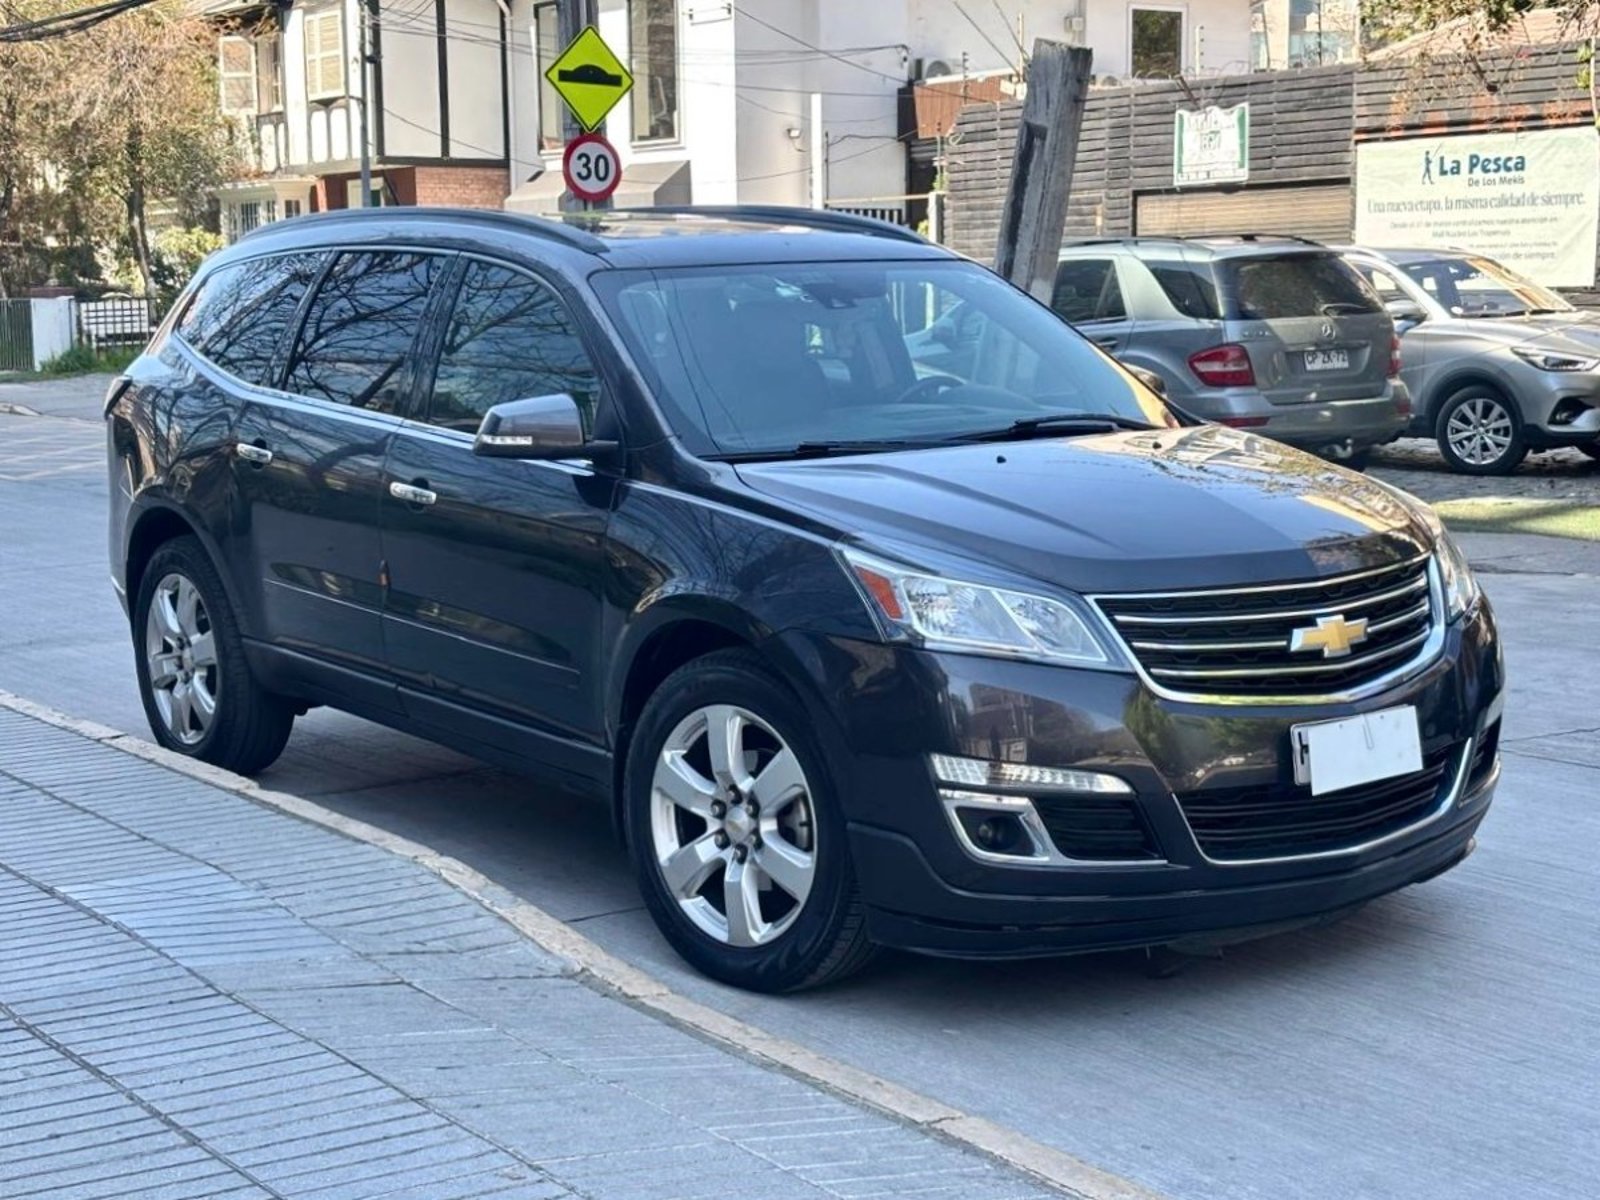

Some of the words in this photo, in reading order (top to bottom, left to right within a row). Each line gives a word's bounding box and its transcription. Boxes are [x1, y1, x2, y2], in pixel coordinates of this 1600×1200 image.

[576, 152, 610, 182] 30
[1439, 155, 1461, 176] La
[1468, 154, 1526, 175] Pesca
[1468, 177, 1480, 187] De
[1482, 177, 1496, 187] Los
[1367, 199, 1385, 213] Una
[1387, 202, 1414, 213] nueva
[1444, 196, 1453, 211] la
[1455, 196, 1488, 210] misma
[1489, 192, 1525, 209] calidad
[1526, 192, 1539, 207] de
